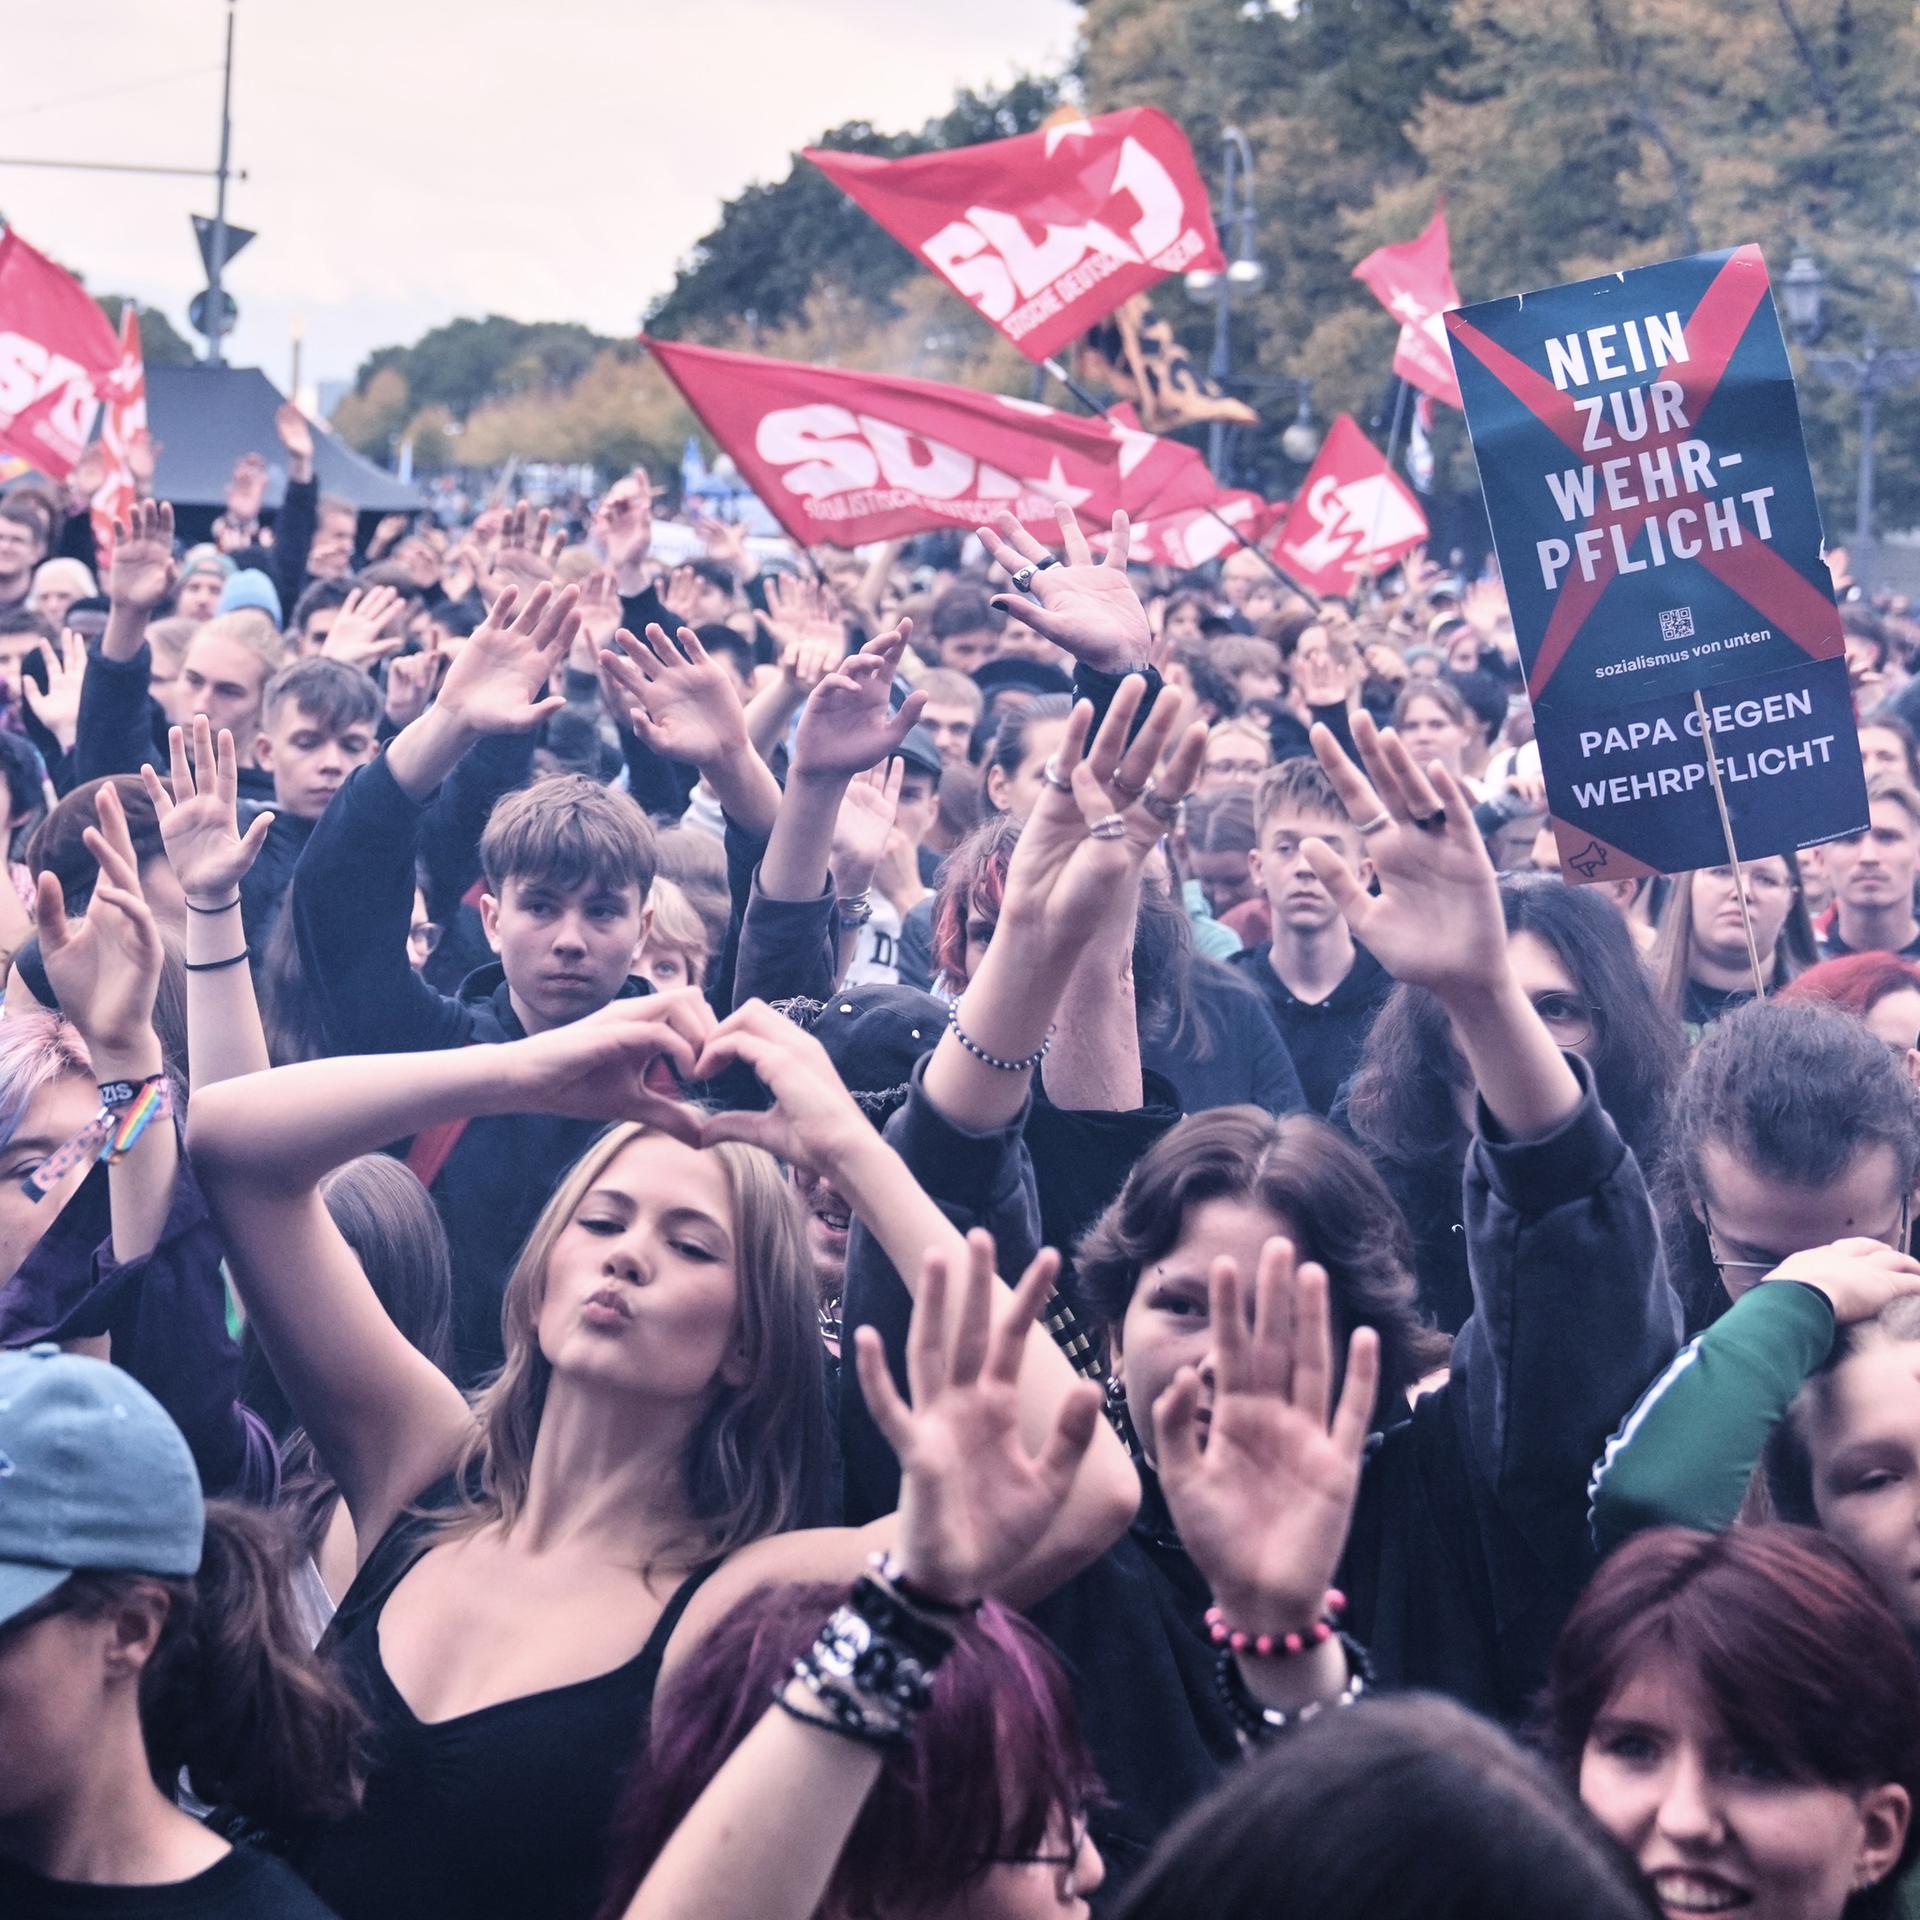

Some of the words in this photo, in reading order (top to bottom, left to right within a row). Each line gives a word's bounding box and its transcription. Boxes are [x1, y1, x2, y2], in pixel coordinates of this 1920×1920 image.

[1544, 311, 1689, 390] NEIN
[1573, 381, 1690, 452] ZUR
[1545, 439, 1743, 522] WEHR-
[1536, 486, 1775, 590] PFLICHT
[1595, 651, 1690, 678] sozialismus
[1692, 641, 1721, 657] von
[1724, 630, 1770, 647] unten
[1579, 717, 1677, 758] PAPA
[1684, 689, 1812, 736] GEGEN
